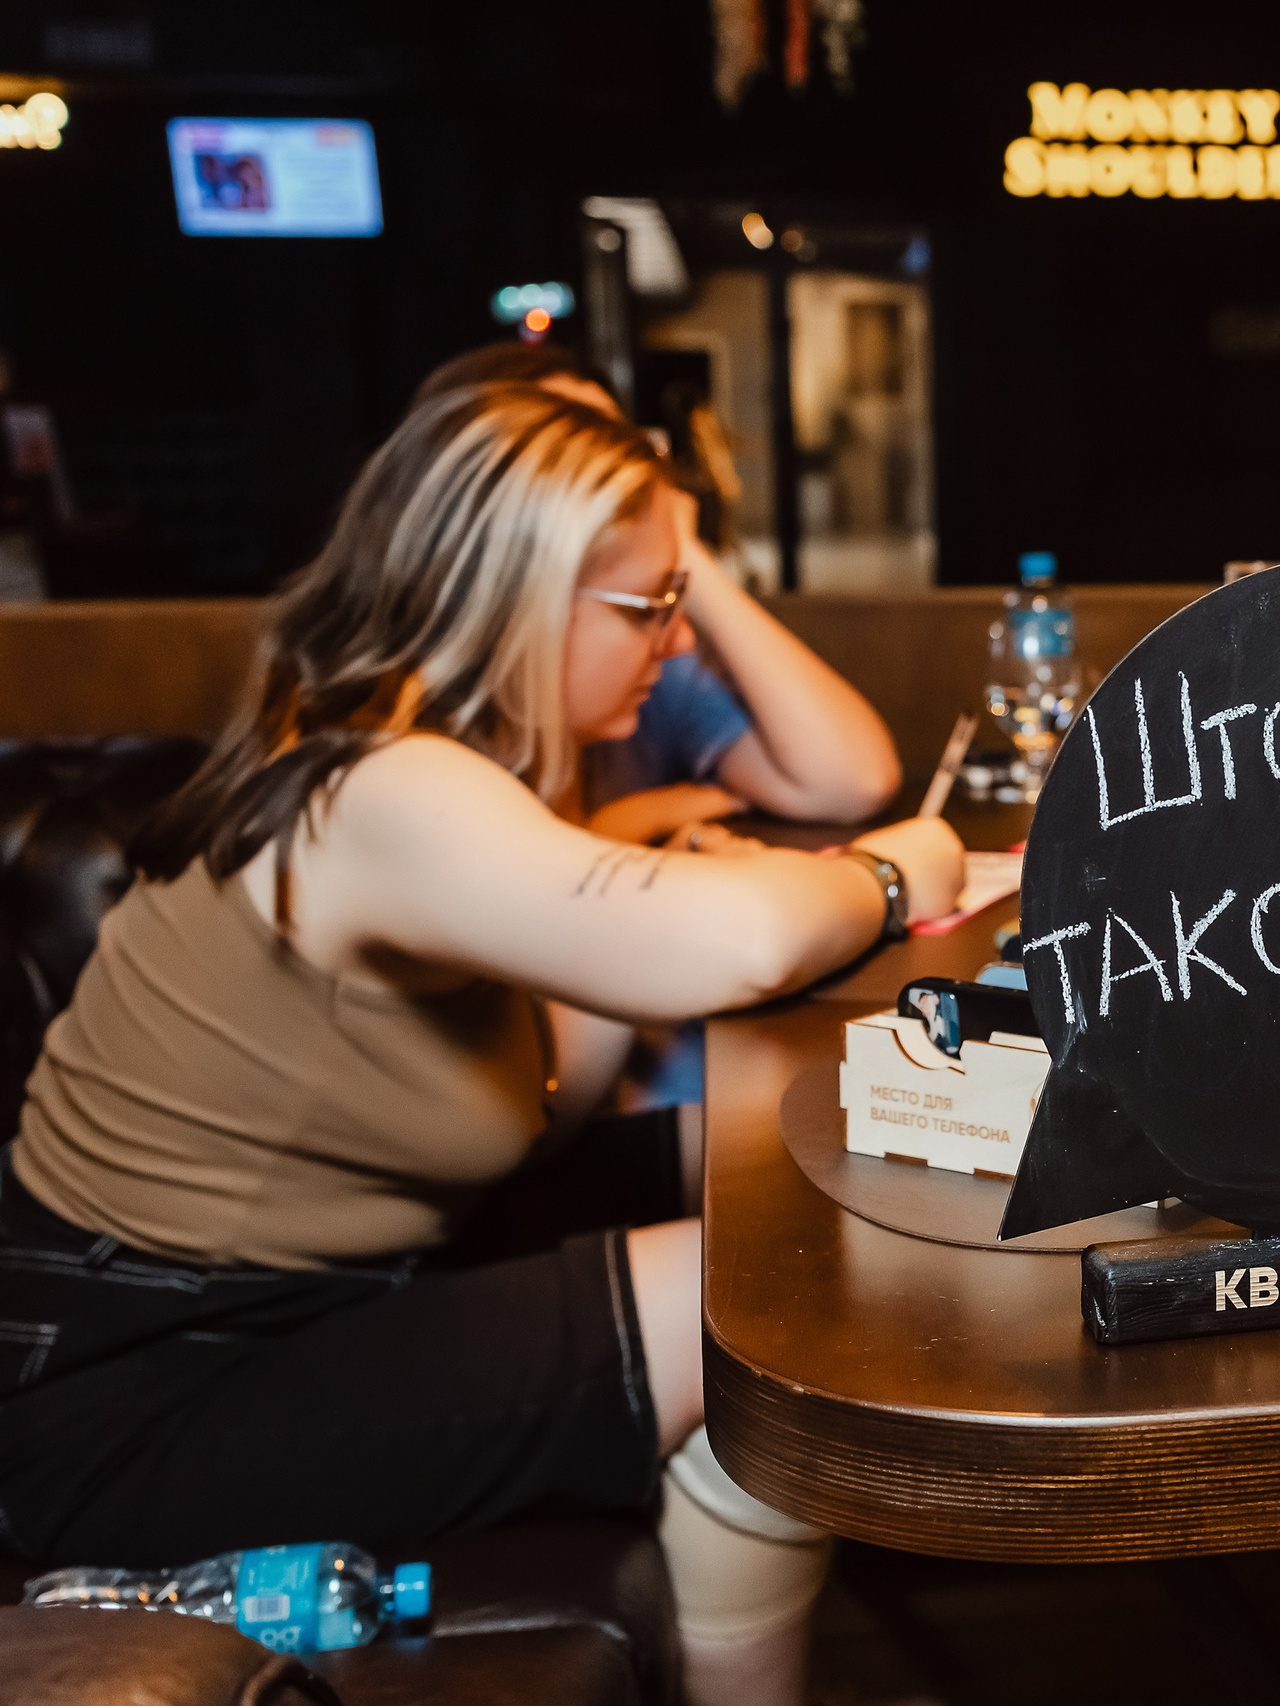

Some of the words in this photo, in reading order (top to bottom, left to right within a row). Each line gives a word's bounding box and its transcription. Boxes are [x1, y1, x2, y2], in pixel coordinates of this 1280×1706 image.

[870, 1086, 919, 1106] МЕСТО
[924, 1094, 953, 1111] ДЛЯ
[870, 1107, 928, 1129] ВАШЕГО
[933, 1117, 1011, 1144] ТЕЛЕФОНА
